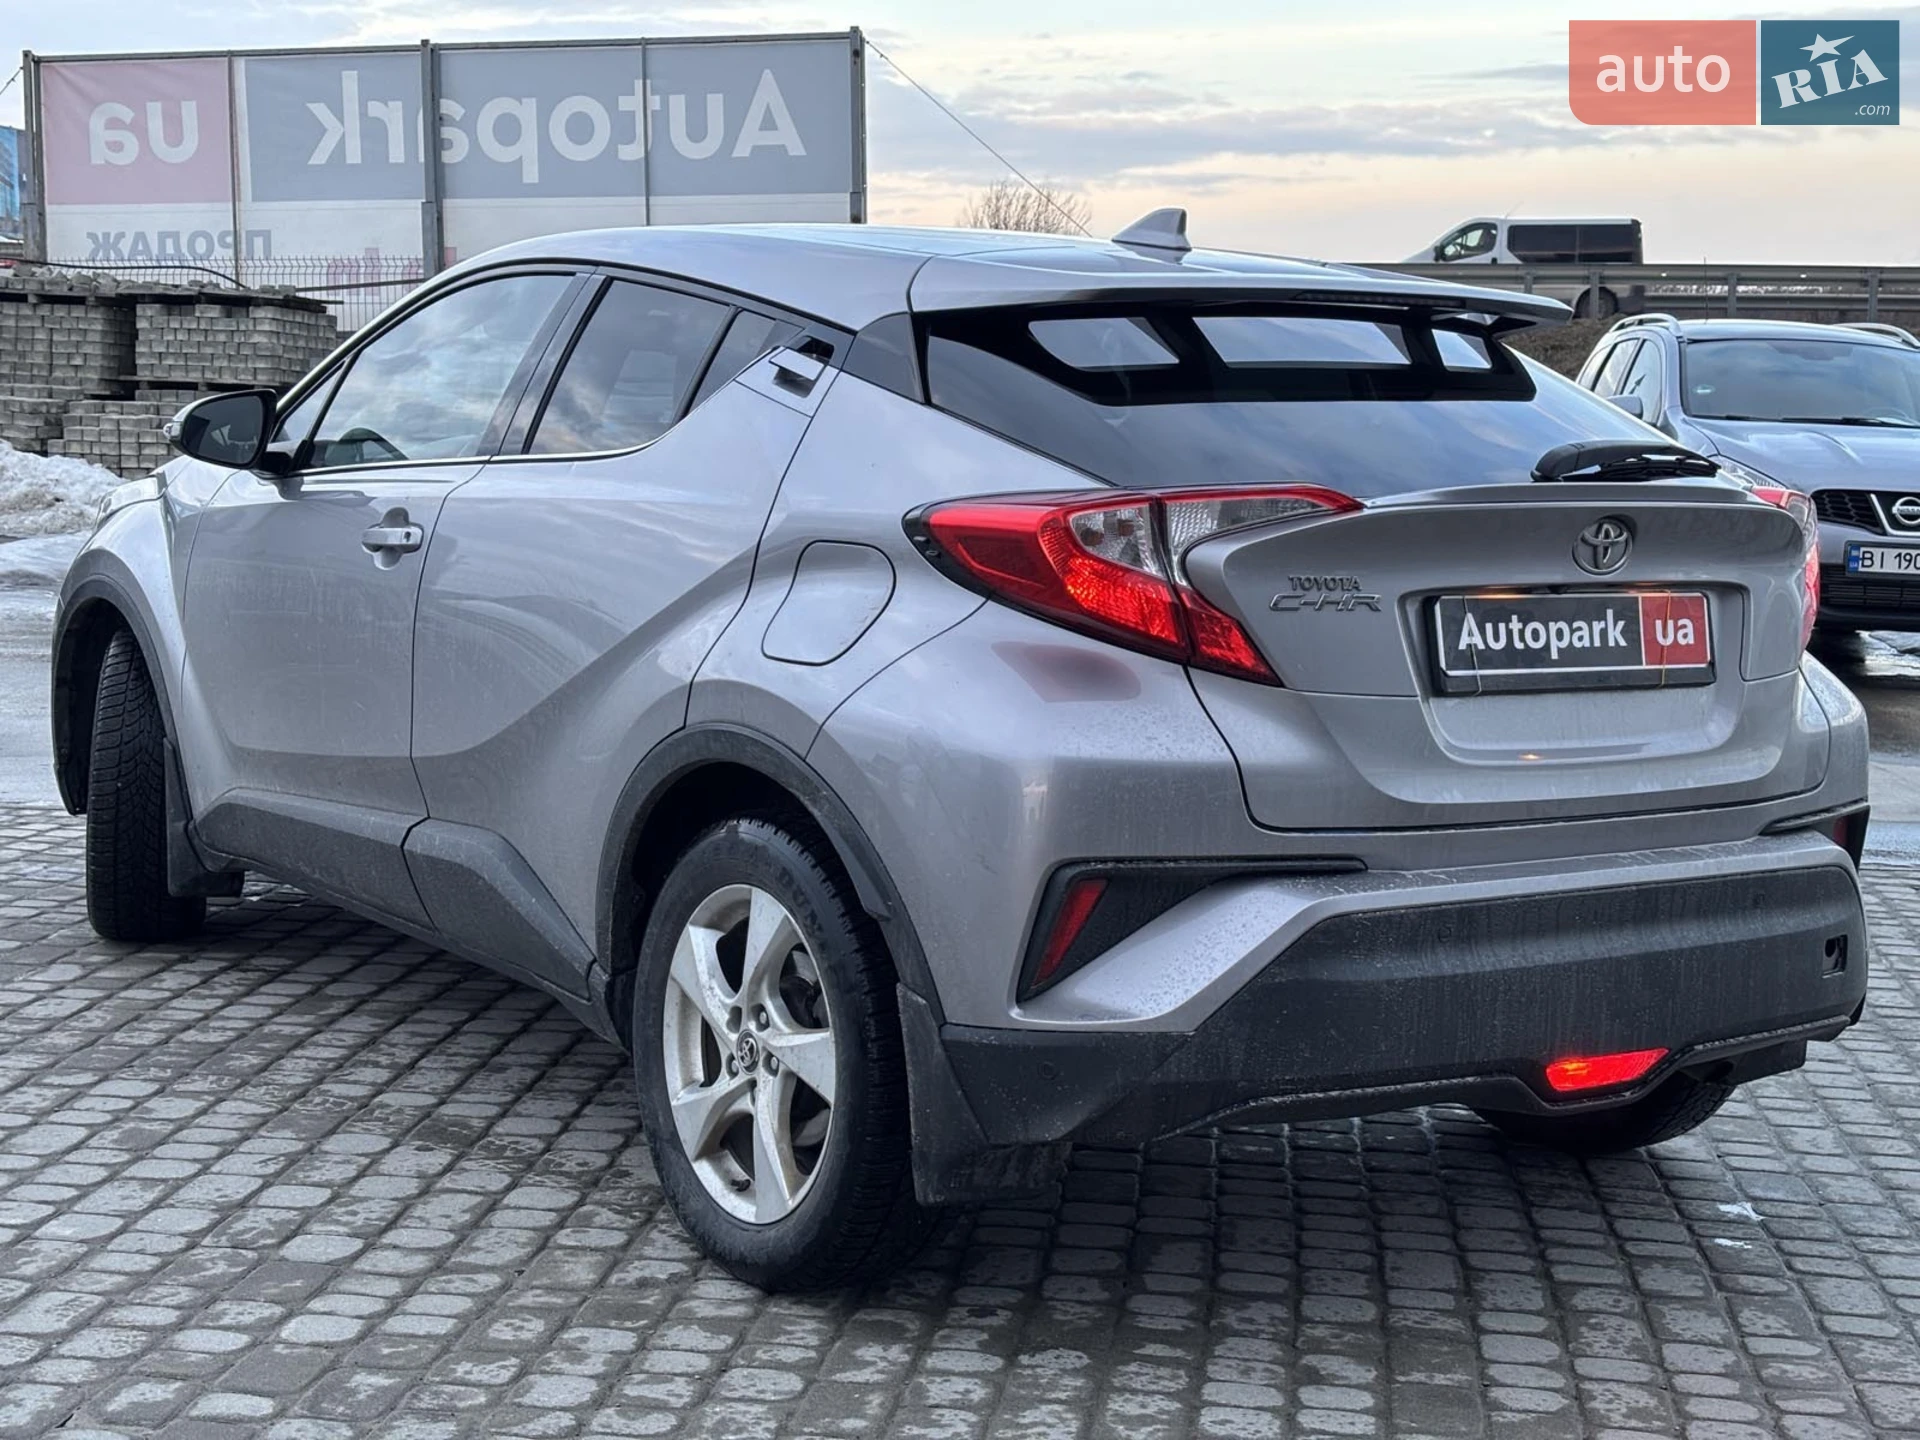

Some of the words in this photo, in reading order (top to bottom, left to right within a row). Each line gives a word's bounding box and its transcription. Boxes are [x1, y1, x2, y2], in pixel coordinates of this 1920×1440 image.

[1861, 550, 1885, 569] BI
[1288, 575, 1362, 592] TOYOTA
[1269, 593, 1382, 612] C-HR
[1458, 609, 1628, 660] Autopark
[1655, 617, 1696, 647] ua
